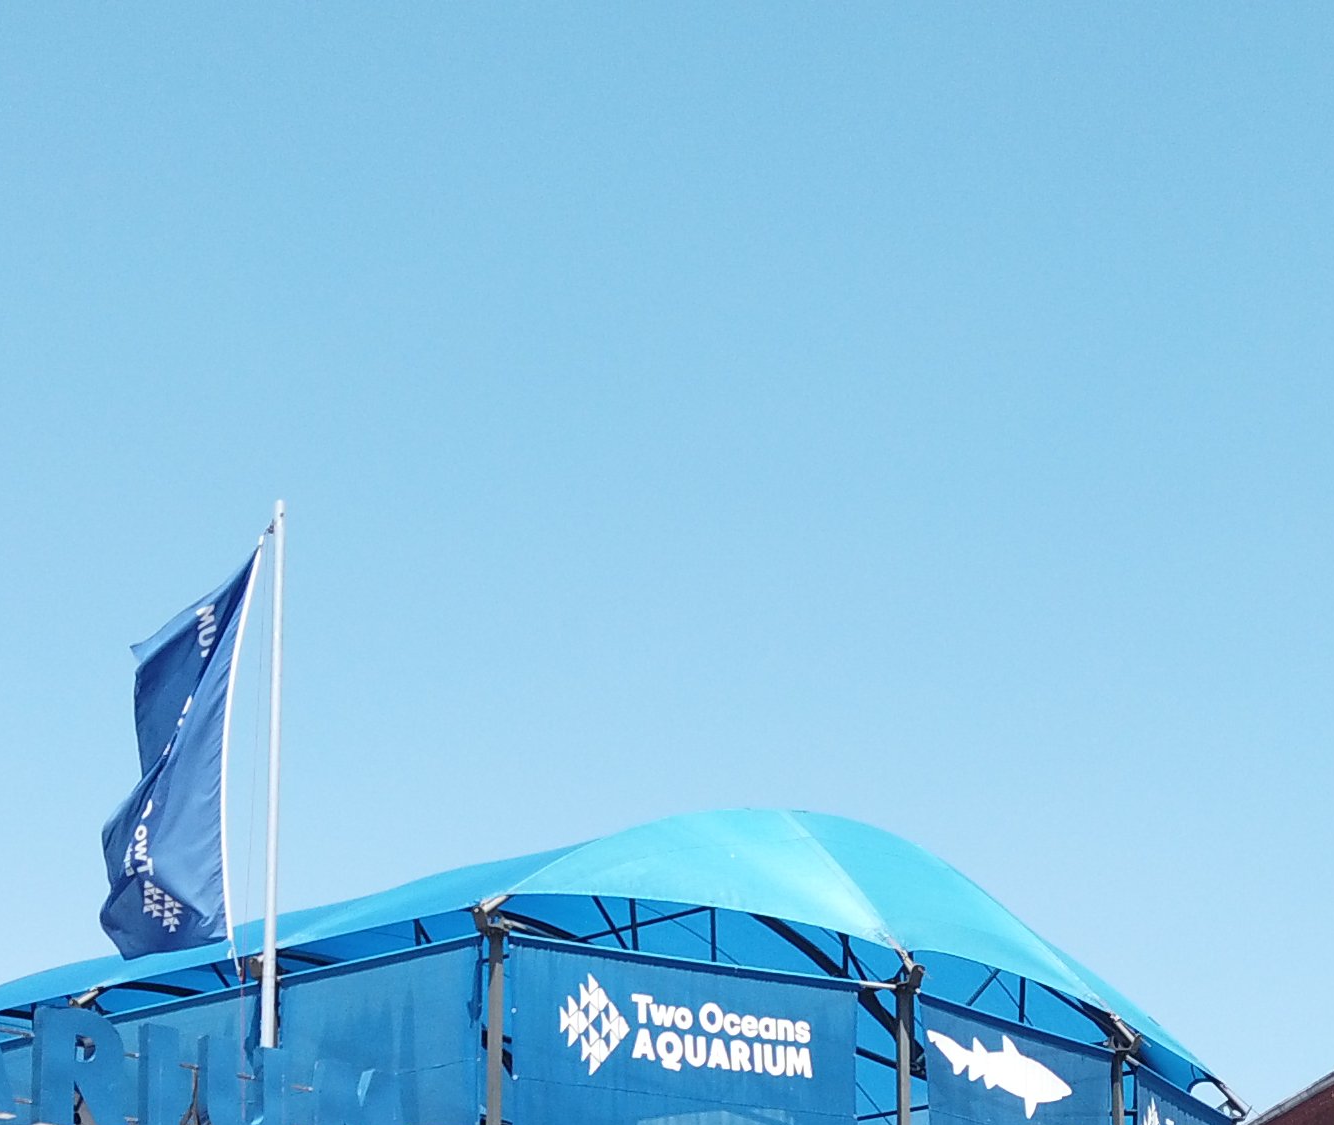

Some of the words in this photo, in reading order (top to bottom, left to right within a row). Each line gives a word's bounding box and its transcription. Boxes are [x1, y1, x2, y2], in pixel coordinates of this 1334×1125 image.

[631, 993, 693, 1030] Two
[698, 1002, 811, 1044] Oceans
[631, 1028, 813, 1079] AQUARIUM
